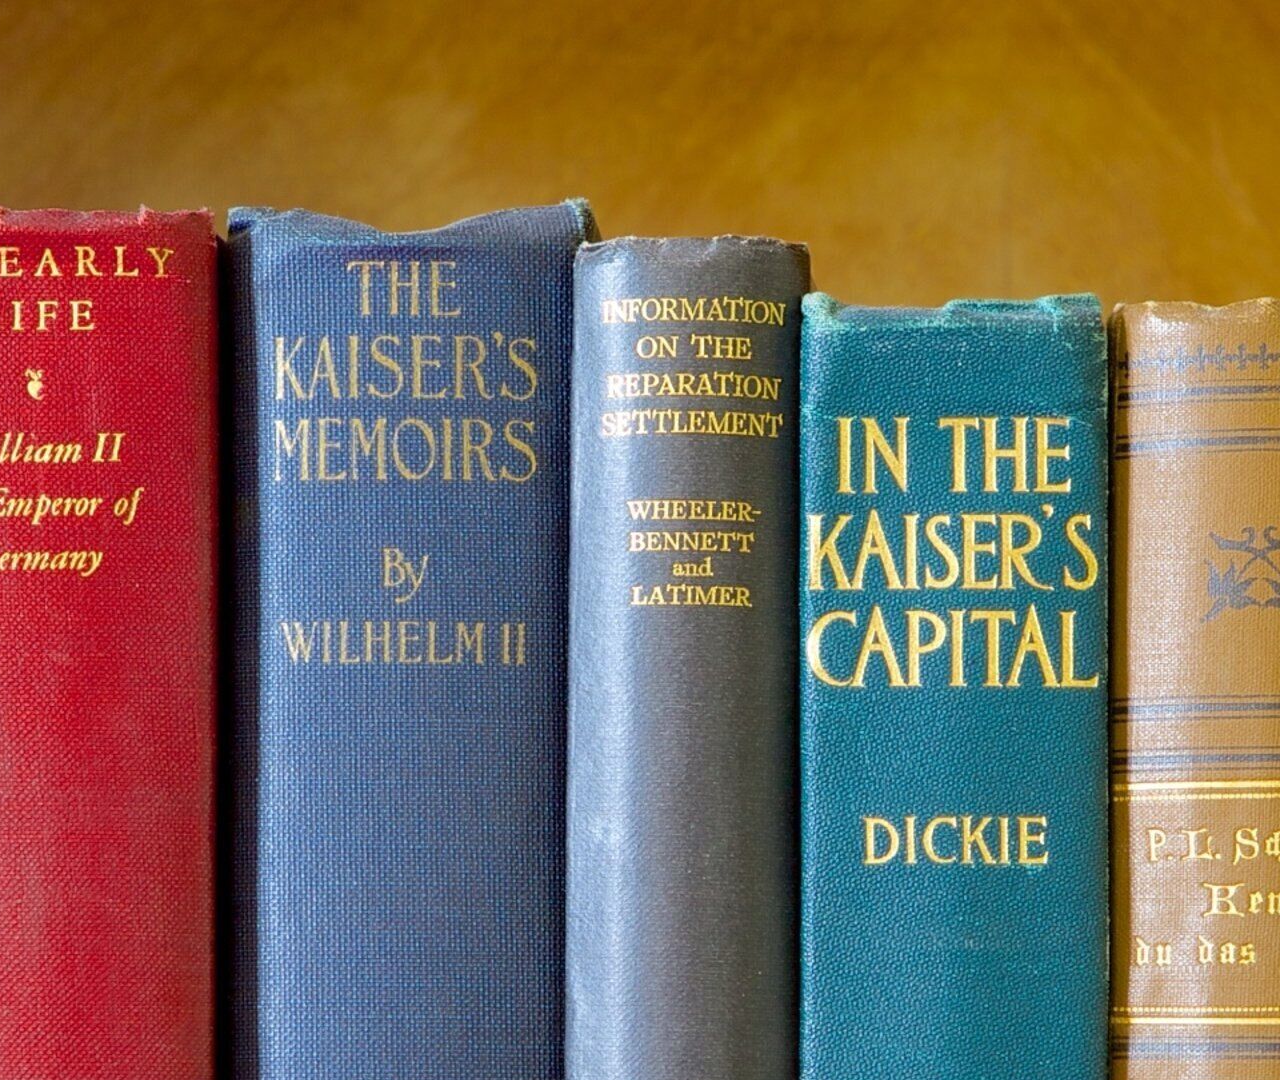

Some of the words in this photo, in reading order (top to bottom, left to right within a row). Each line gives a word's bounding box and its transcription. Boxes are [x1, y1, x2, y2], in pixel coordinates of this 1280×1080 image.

[347, 261, 462, 318] THE
[602, 296, 787, 327] INFORMATION
[636, 335, 677, 361] ON
[690, 333, 753, 361] THE
[273, 330, 539, 401] KAISER'S
[606, 371, 782, 401] REPARATION
[601, 409, 784, 438] SETTLEMENT
[92, 432, 125, 464] II
[273, 417, 539, 484] MEMOIRS
[835, 416, 910, 495] IN
[938, 415, 1073, 494] THE
[114, 487, 145, 526] of
[627, 501, 761, 523] WHEELER-
[628, 532, 755, 554] BENNETT
[806, 504, 1100, 591] KAISER'S
[382, 547, 431, 604] By
[672, 556, 713, 578] and
[630, 586, 753, 608] LATIMER
[280, 620, 487, 667] WILHELM
[500, 621, 527, 667] II
[806, 602, 1100, 688] CAPITAL
[862, 814, 1049, 866] DICKIE
[1136, 937, 1172, 966] du
[1198, 935, 1257, 966] das
